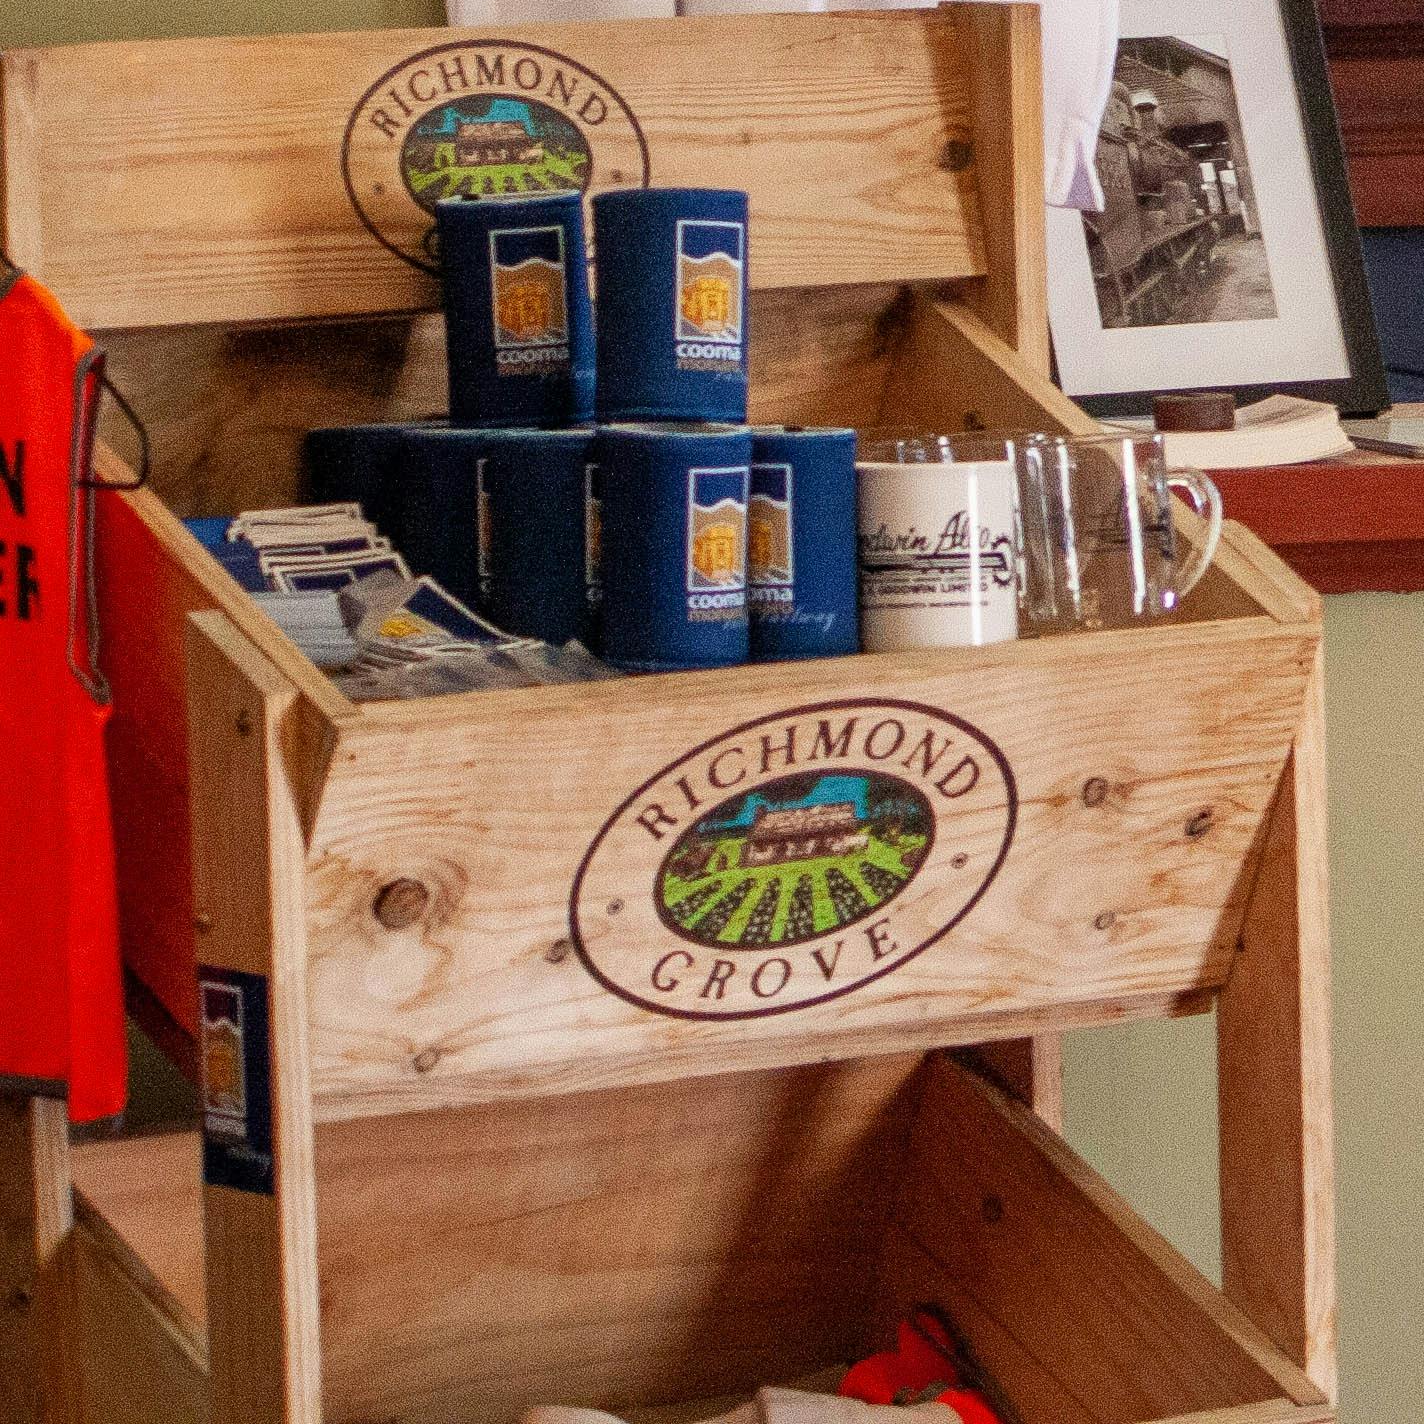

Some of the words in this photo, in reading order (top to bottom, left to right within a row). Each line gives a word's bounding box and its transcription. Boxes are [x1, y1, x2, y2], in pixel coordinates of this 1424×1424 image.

[369, 54, 609, 141] RICHMOND
[636, 717, 981, 840] RICHMOND
[651, 917, 900, 1000] GROVE
